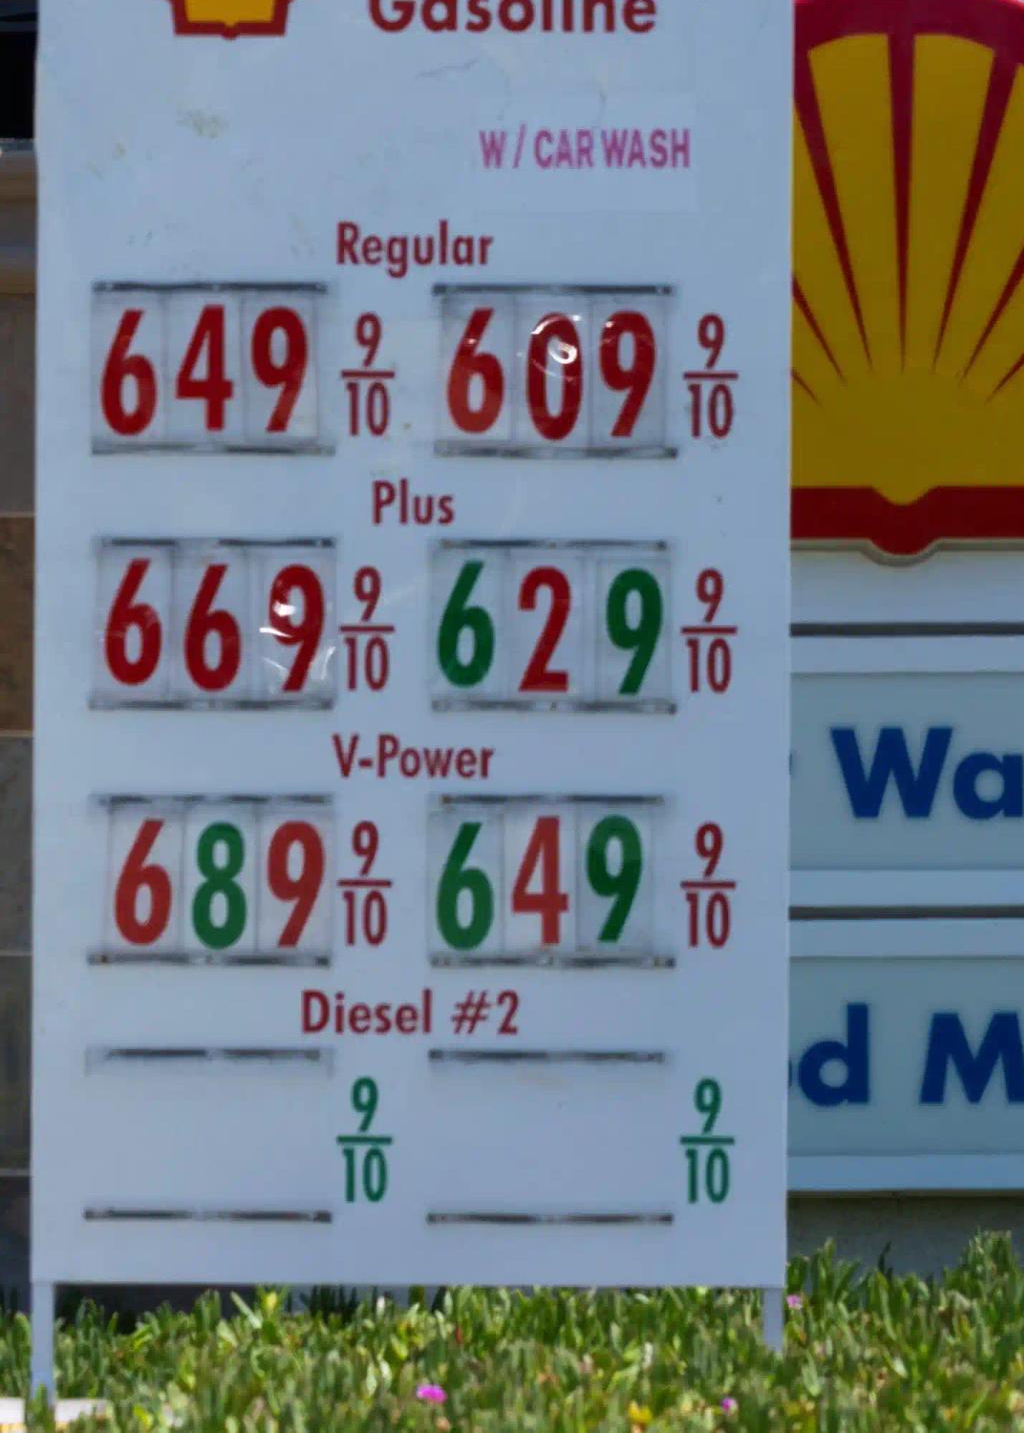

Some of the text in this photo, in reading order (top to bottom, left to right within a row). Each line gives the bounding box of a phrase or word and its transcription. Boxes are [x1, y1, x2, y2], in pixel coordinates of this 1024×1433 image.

[337, 220, 493, 279] Regular
[99, 304, 309, 437] 649
[445, 308, 656, 441] 609
[372, 480, 455, 526] Plus
[104, 558, 325, 694] 669
[437, 559, 664, 696] 629
[333, 732, 494, 780] V-Power
[114, 817, 327, 951] 689
[436, 815, 643, 952] 649
[301, 987, 520, 1035] Diesel #2
